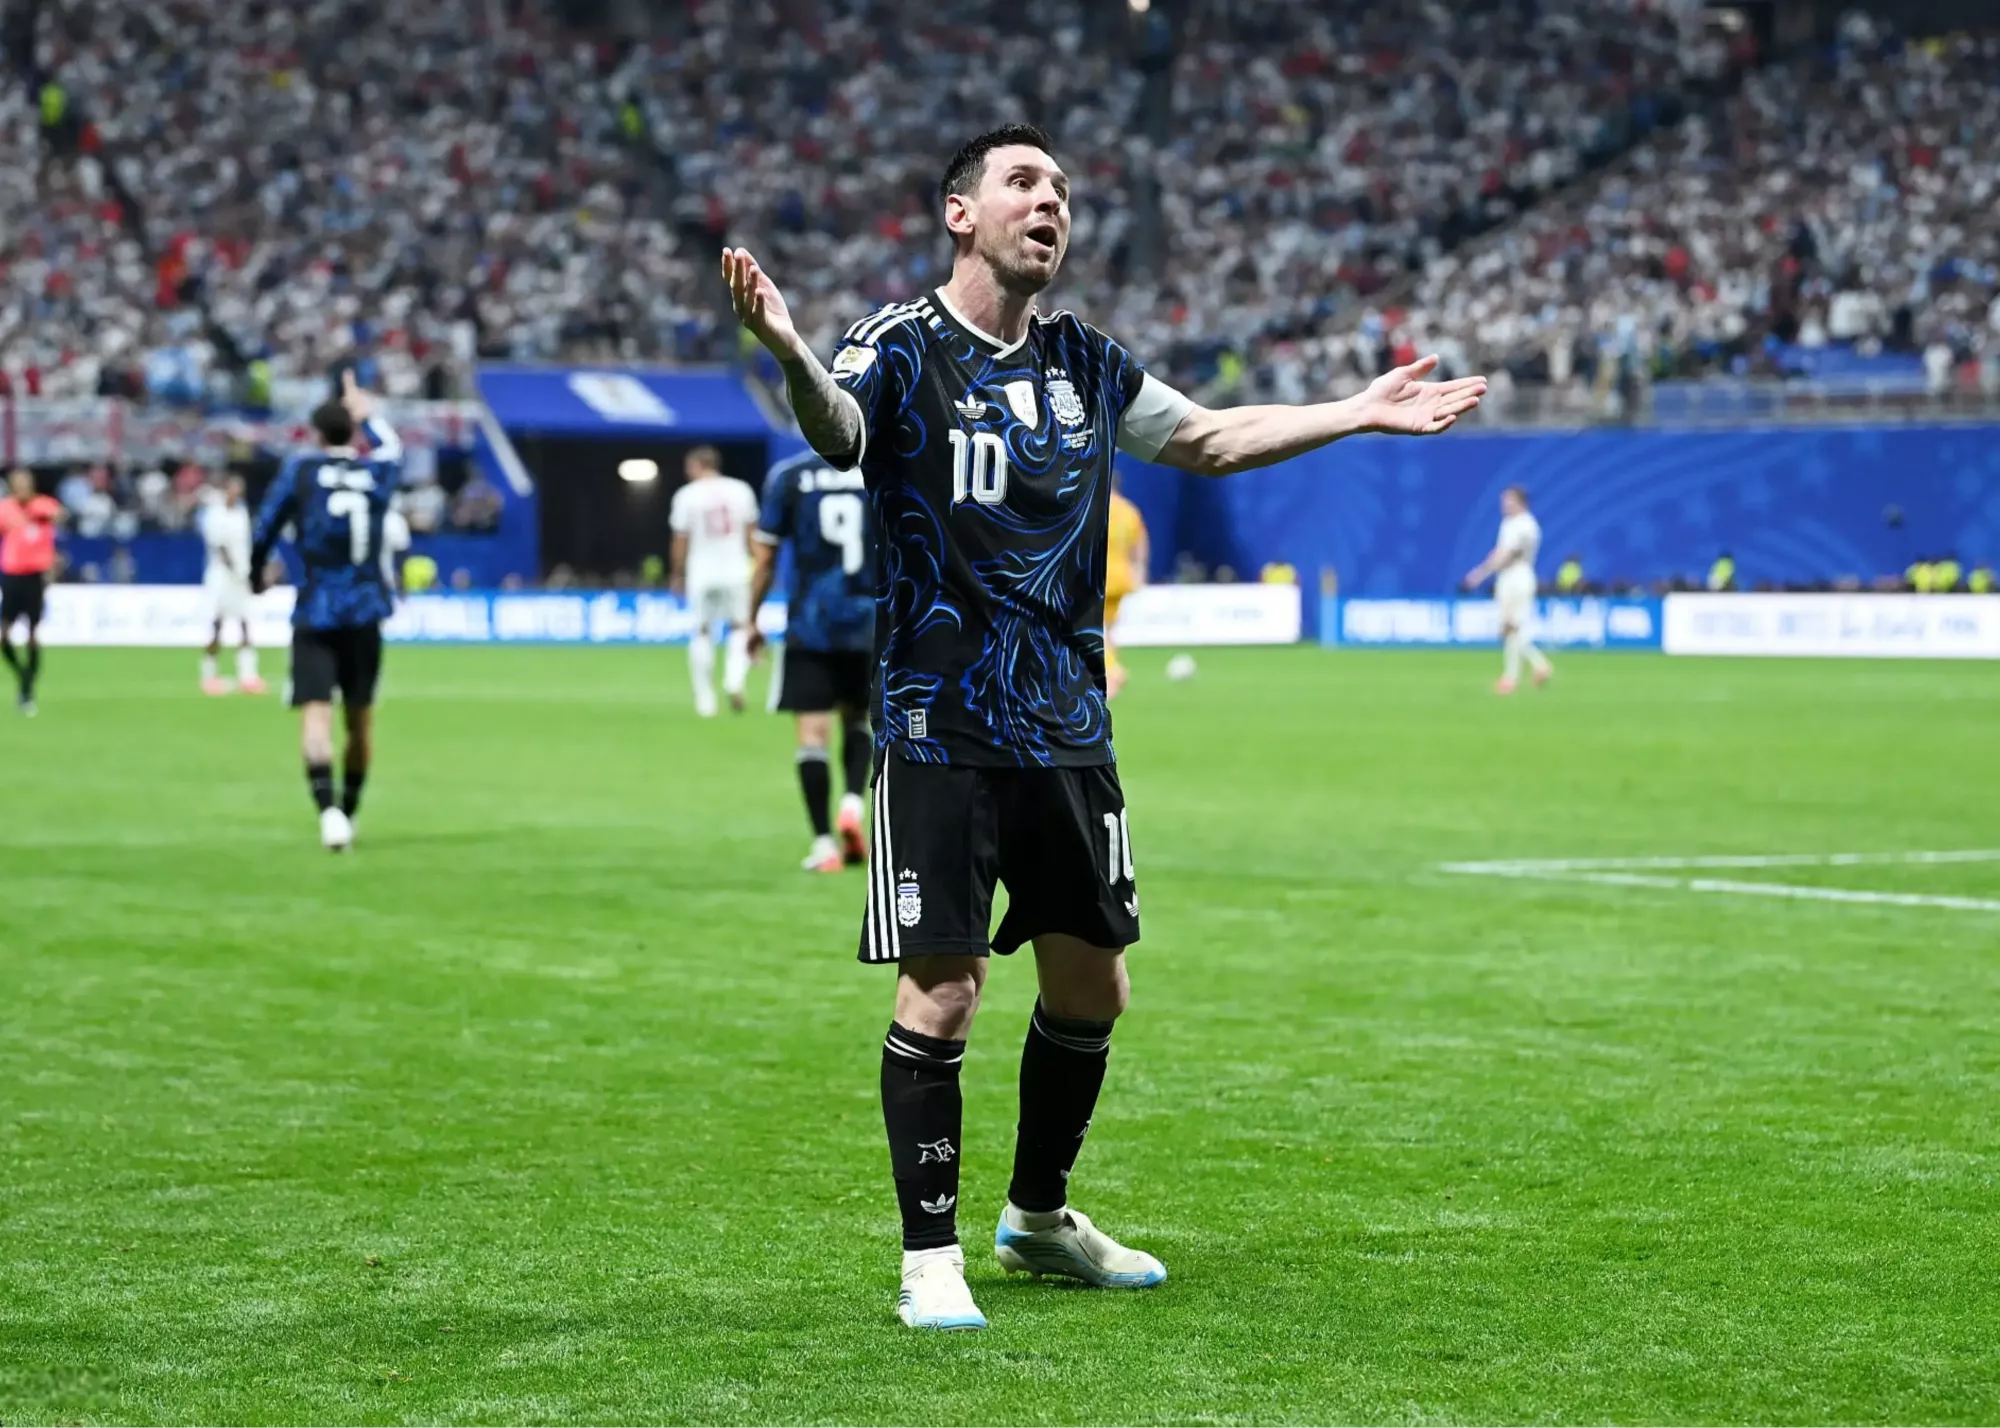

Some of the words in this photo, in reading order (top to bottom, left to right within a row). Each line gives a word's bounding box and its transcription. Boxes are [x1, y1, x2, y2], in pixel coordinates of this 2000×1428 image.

[948, 429, 1008, 506] 10
[327, 490, 370, 566] 7
[819, 493, 864, 575] 9
